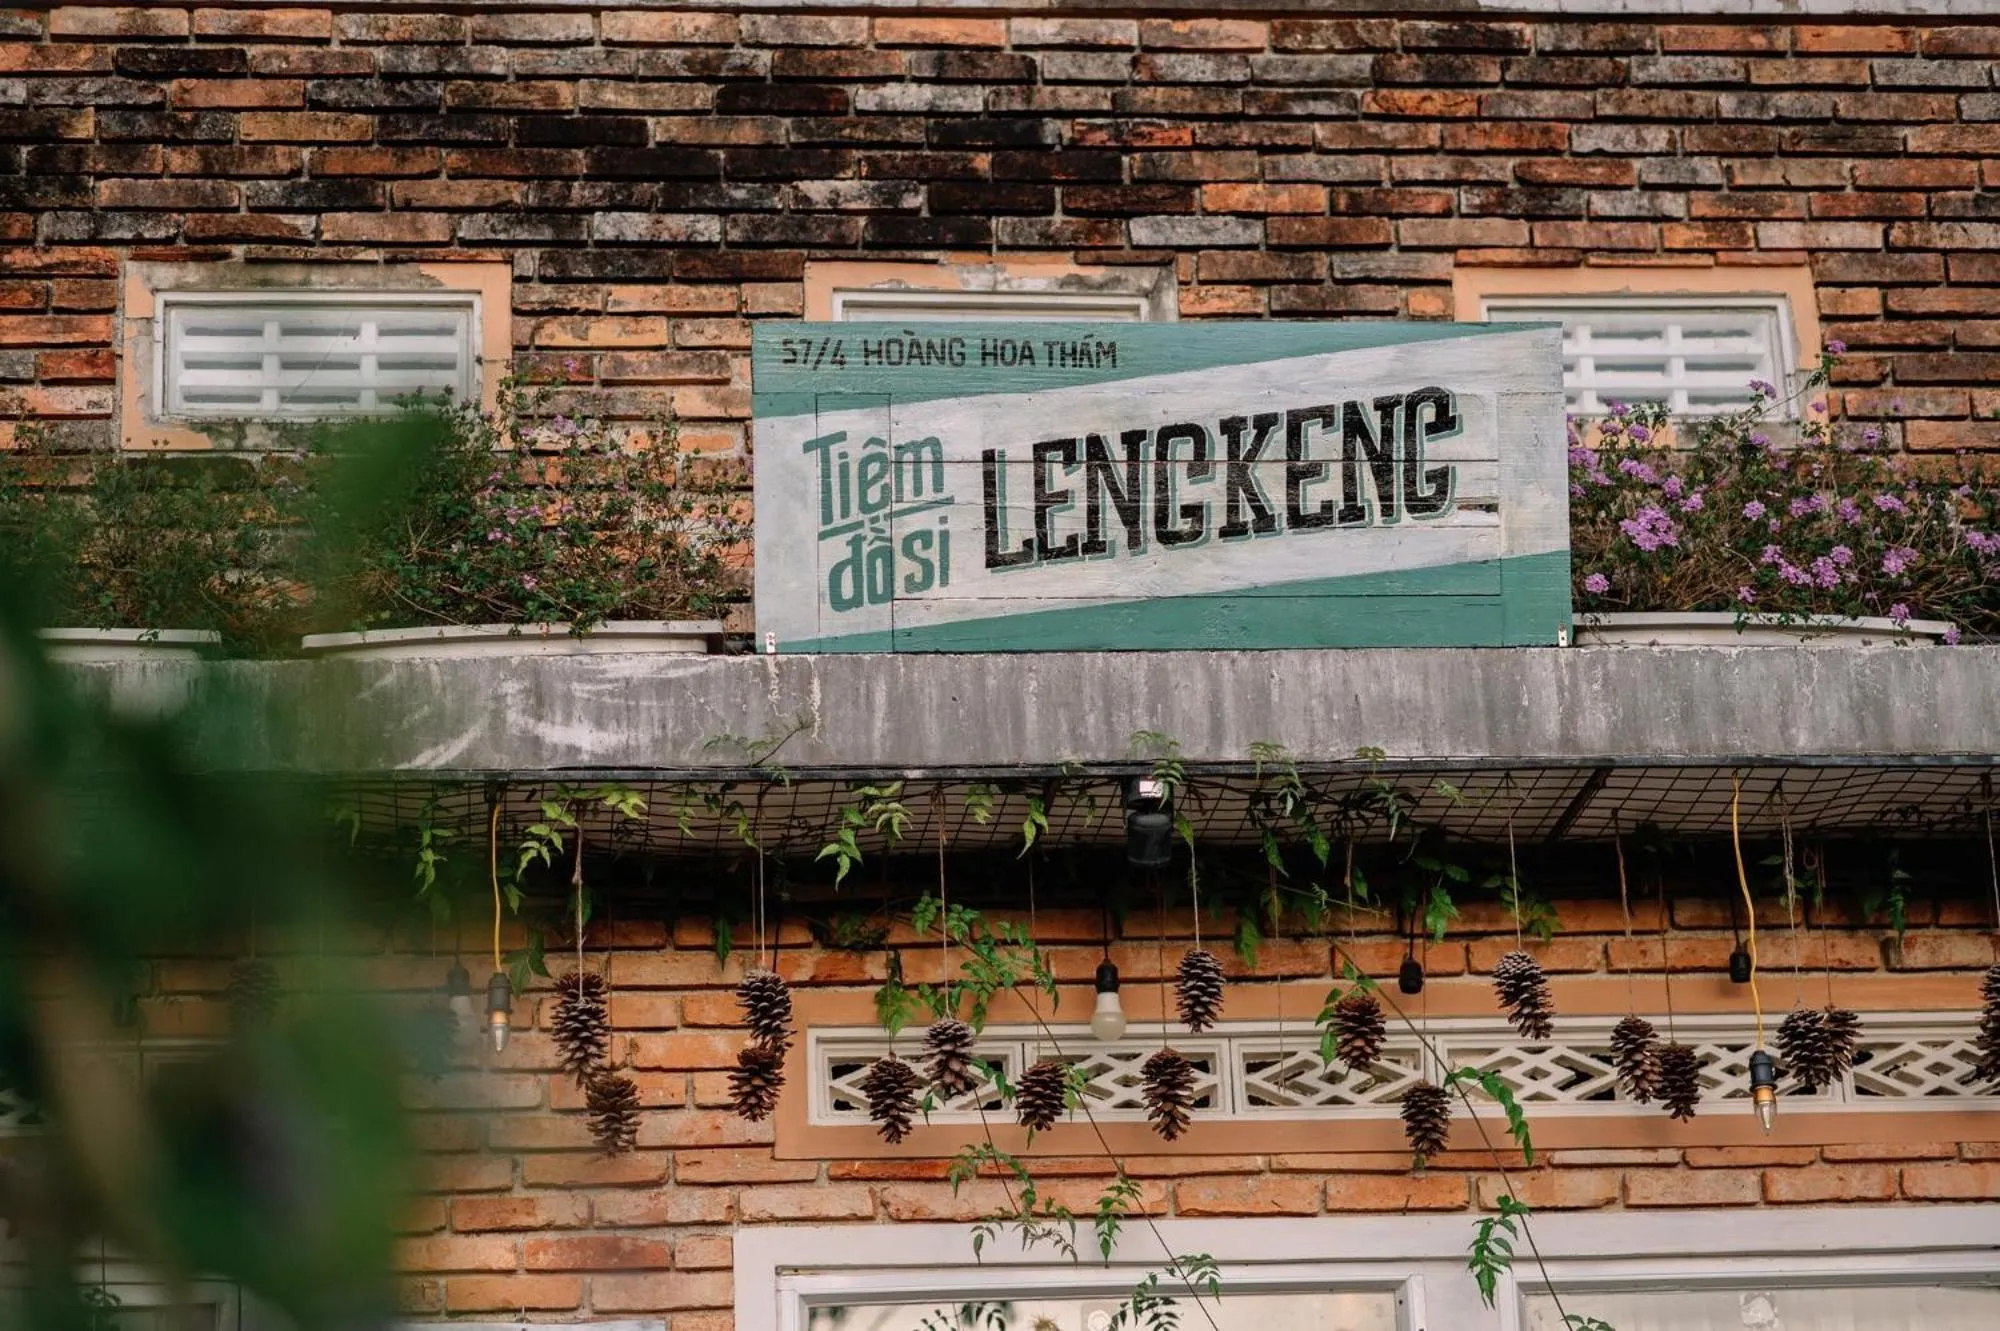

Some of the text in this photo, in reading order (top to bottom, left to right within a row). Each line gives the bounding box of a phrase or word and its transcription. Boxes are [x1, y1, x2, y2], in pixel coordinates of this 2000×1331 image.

[781, 329, 1117, 371] 57/4 HOÀNG HOA THÁM
[981, 385, 1464, 572] LENGKENG
[828, 515, 950, 612] đồ si
